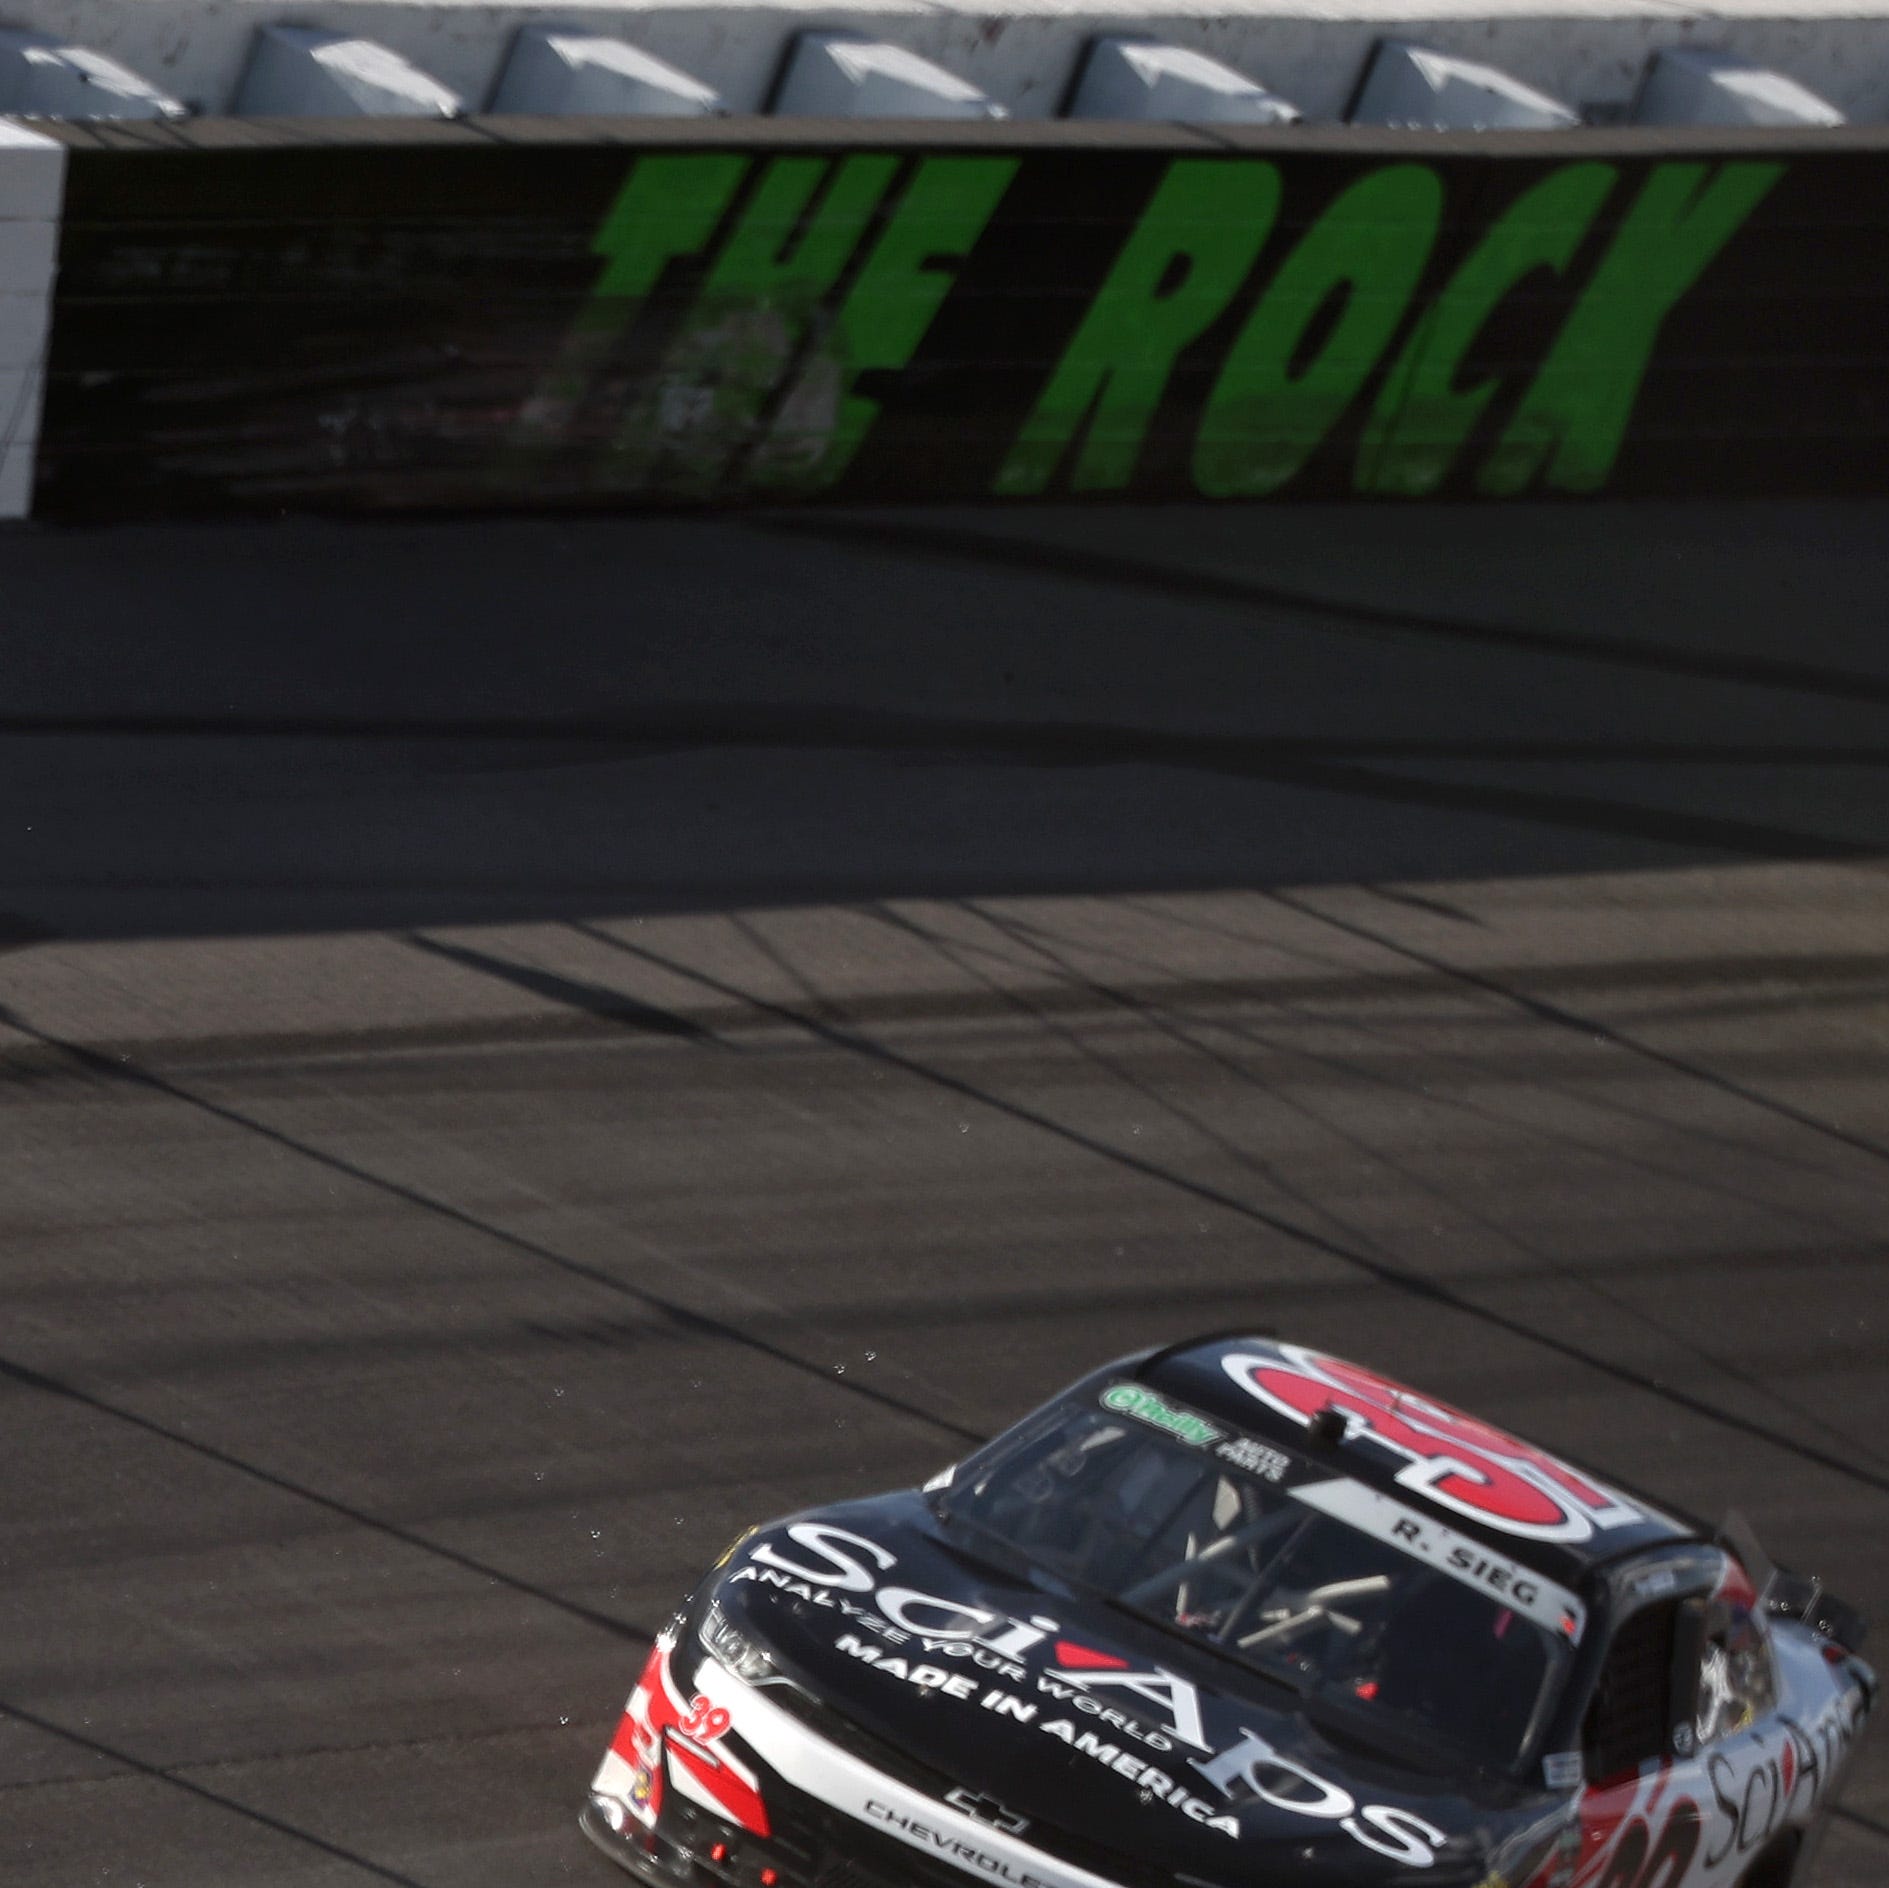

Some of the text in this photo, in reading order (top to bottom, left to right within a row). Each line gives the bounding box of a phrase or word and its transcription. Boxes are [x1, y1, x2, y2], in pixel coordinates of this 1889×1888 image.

[552, 153, 1784, 496] THE ROCK
[1391, 1517, 1540, 1607] R. SIEG
[677, 1693, 733, 1746] 39
[729, 1565, 1174, 1752] ANALYZE YOUR WORLD
[834, 1633, 1241, 1840] MADE IN AMERICA
